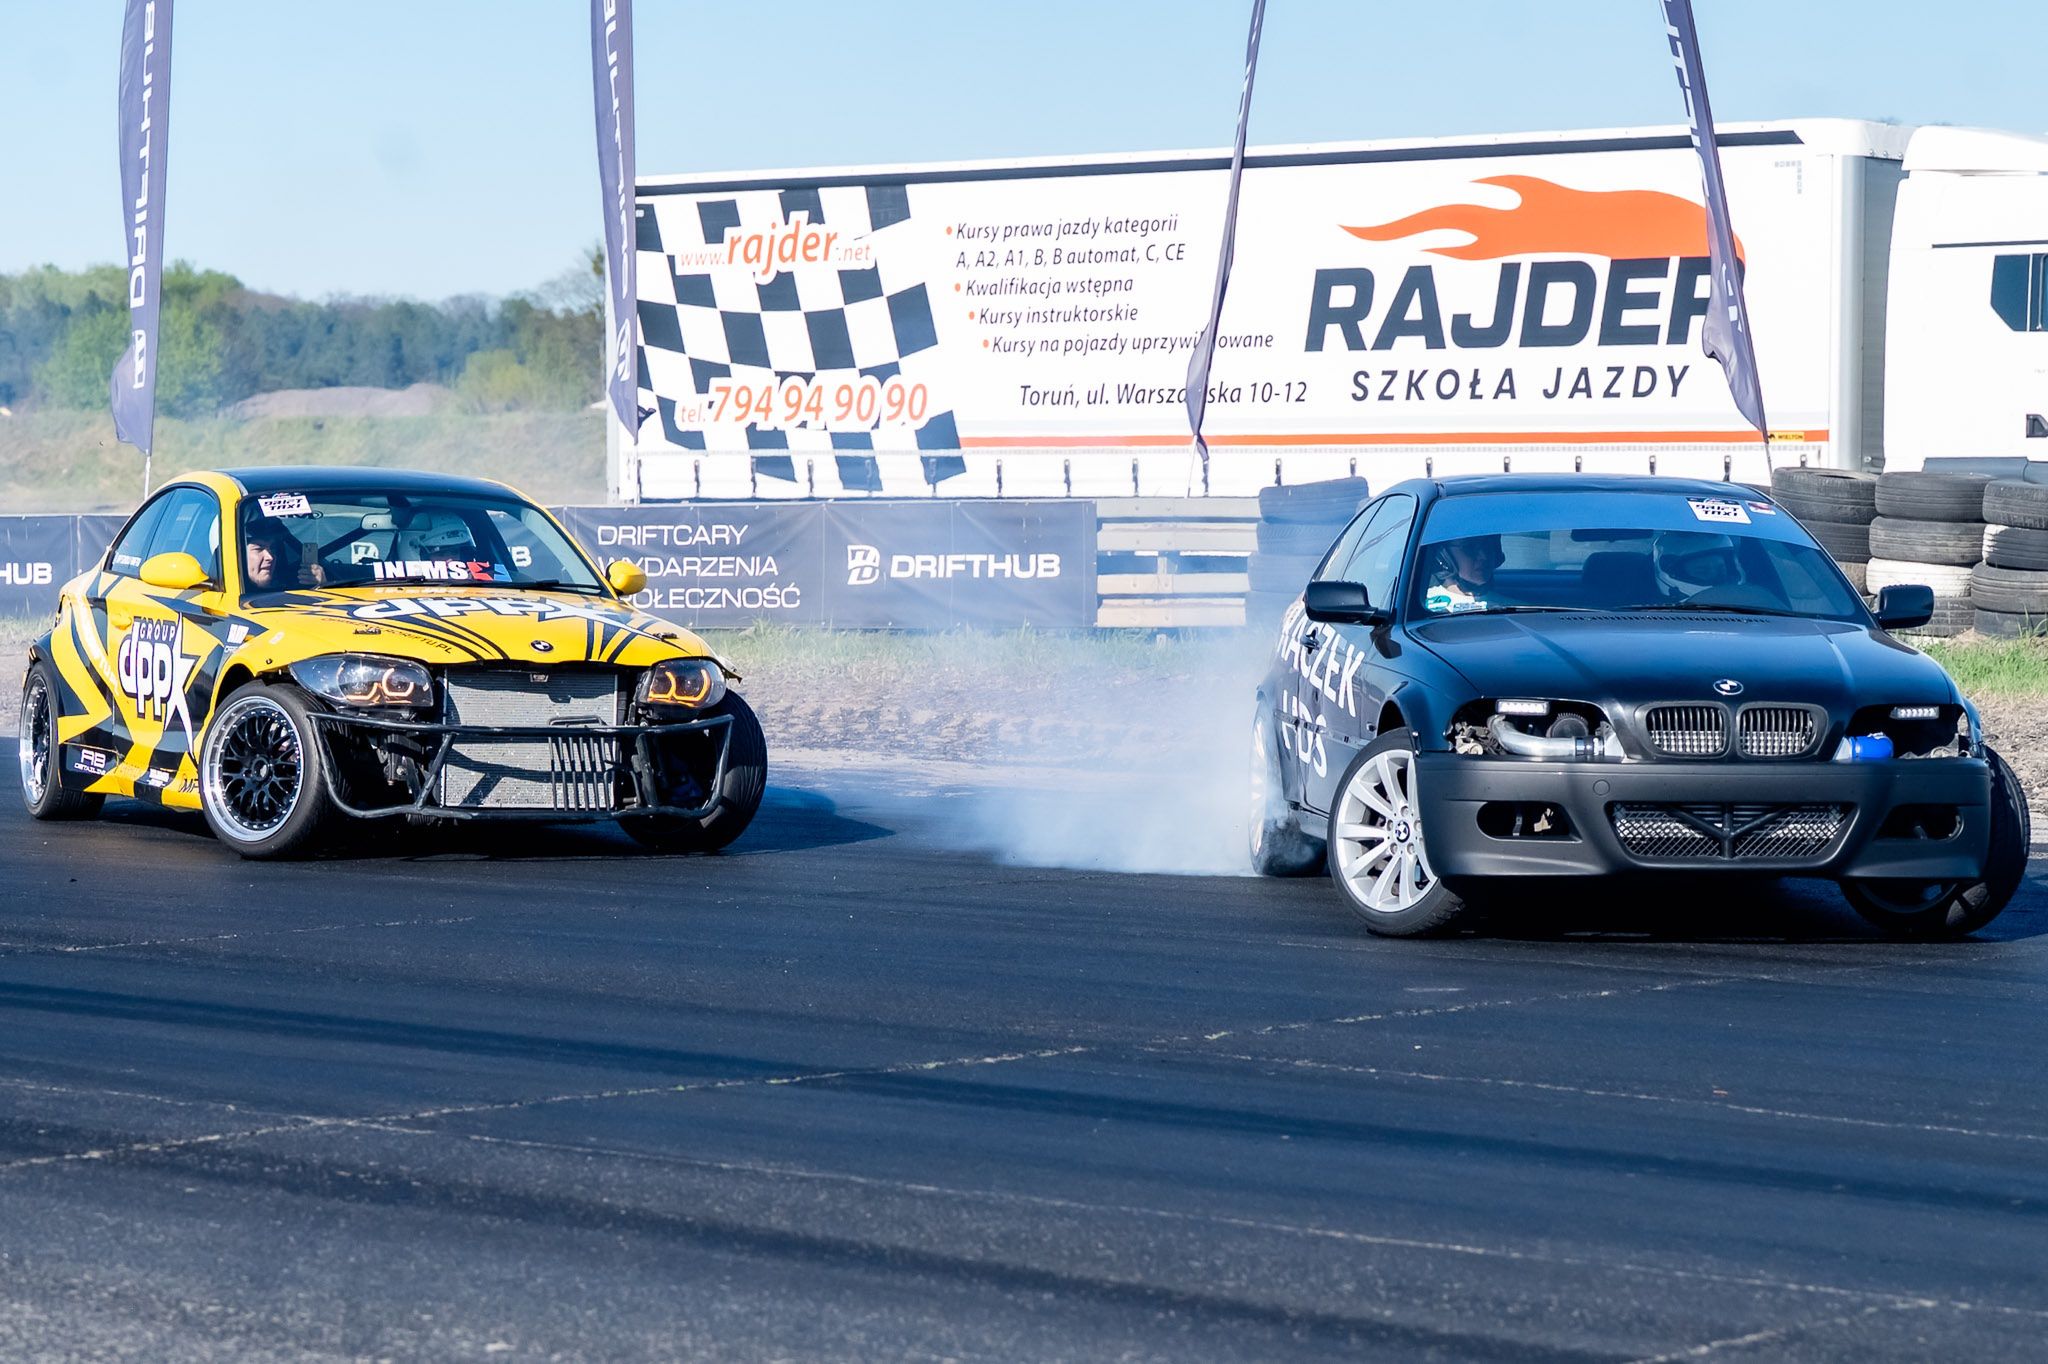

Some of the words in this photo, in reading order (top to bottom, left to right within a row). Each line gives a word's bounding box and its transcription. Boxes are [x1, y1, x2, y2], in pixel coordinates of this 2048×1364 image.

[956, 222, 1000, 244] Kursy
[1002, 223, 1053, 243] prawa
[1055, 217, 1101, 240] jazdy
[1104, 213, 1178, 238] kategorii
[955, 251, 970, 270] A,
[974, 250, 1000, 268] A2,
[1004, 249, 1029, 267] A1,
[1033, 248, 1047, 266] B,
[1052, 247, 1063, 265] B
[1066, 246, 1140, 265] automat,
[1145, 243, 1160, 264] C,
[1165, 243, 1186, 261] CE
[966, 278, 1062, 300] Kwalifikacja
[1066, 277, 1134, 298] wstępna
[979, 306, 1023, 329] Kursy
[1026, 303, 1139, 324] instruktorskie
[992, 335, 1036, 358] Kursy
[1039, 339, 1060, 353] na
[1063, 334, 1128, 357] pojazdy
[1132, 329, 1274, 355] uprzywiowane
[1020, 383, 1080, 409] Toruń,
[1086, 382, 1109, 406] ul.
[1117, 379, 1242, 406] Warszaska
[1250, 381, 1308, 404] 10-12
[1351, 367, 1518, 402] SZKOŁA
[1543, 364, 1690, 399] JAZDY
[680, 404, 706, 423] tel.
[713, 385, 774, 423] 794
[784, 384, 823, 422] 94
[834, 384, 876, 422] 90
[887, 383, 928, 422] 90
[597, 524, 749, 547] DRIFTCARY
[890, 553, 1062, 579] DRIFTHUB
[139, 621, 176, 643] GROUP
